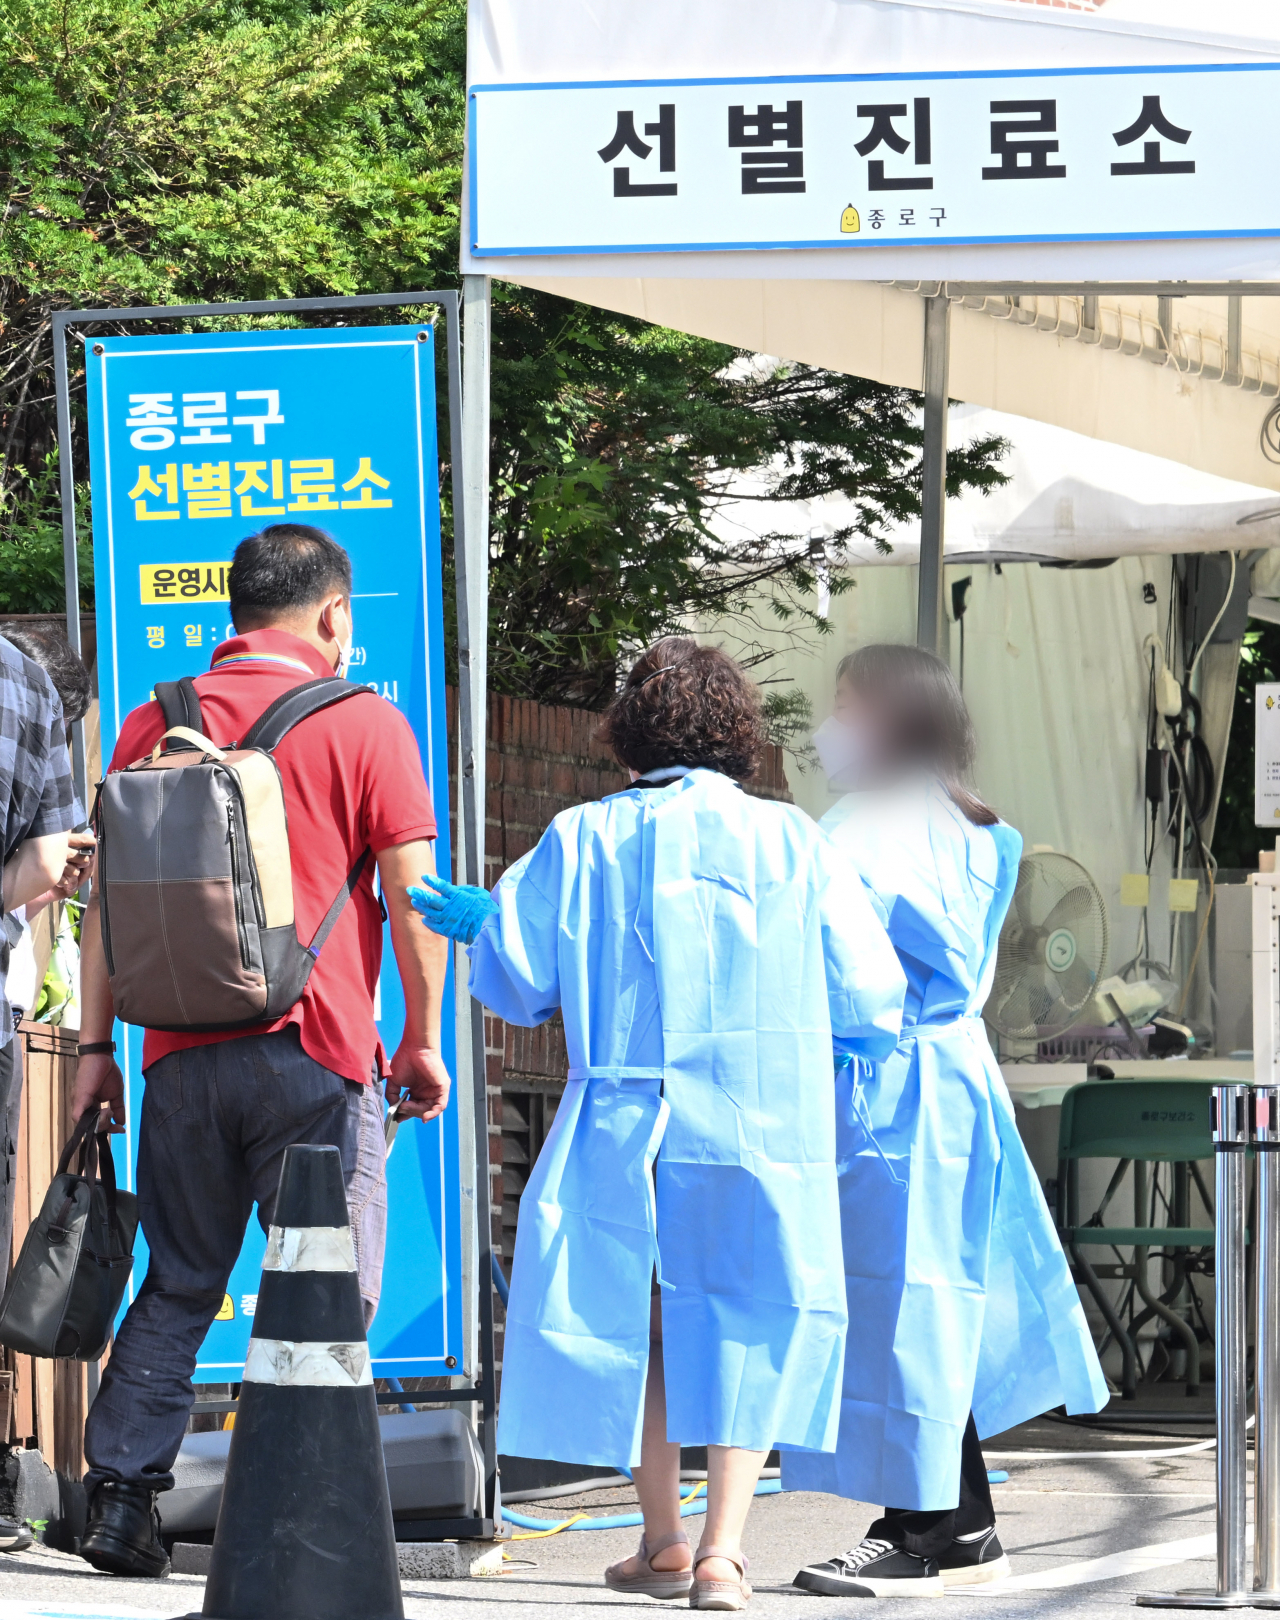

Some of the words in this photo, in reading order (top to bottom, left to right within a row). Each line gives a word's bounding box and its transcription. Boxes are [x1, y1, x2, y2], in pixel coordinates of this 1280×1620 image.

[125, 389, 285, 451] 종로구
[127, 456, 393, 521] 선별진료소
[152, 567, 232, 598] 운영시
